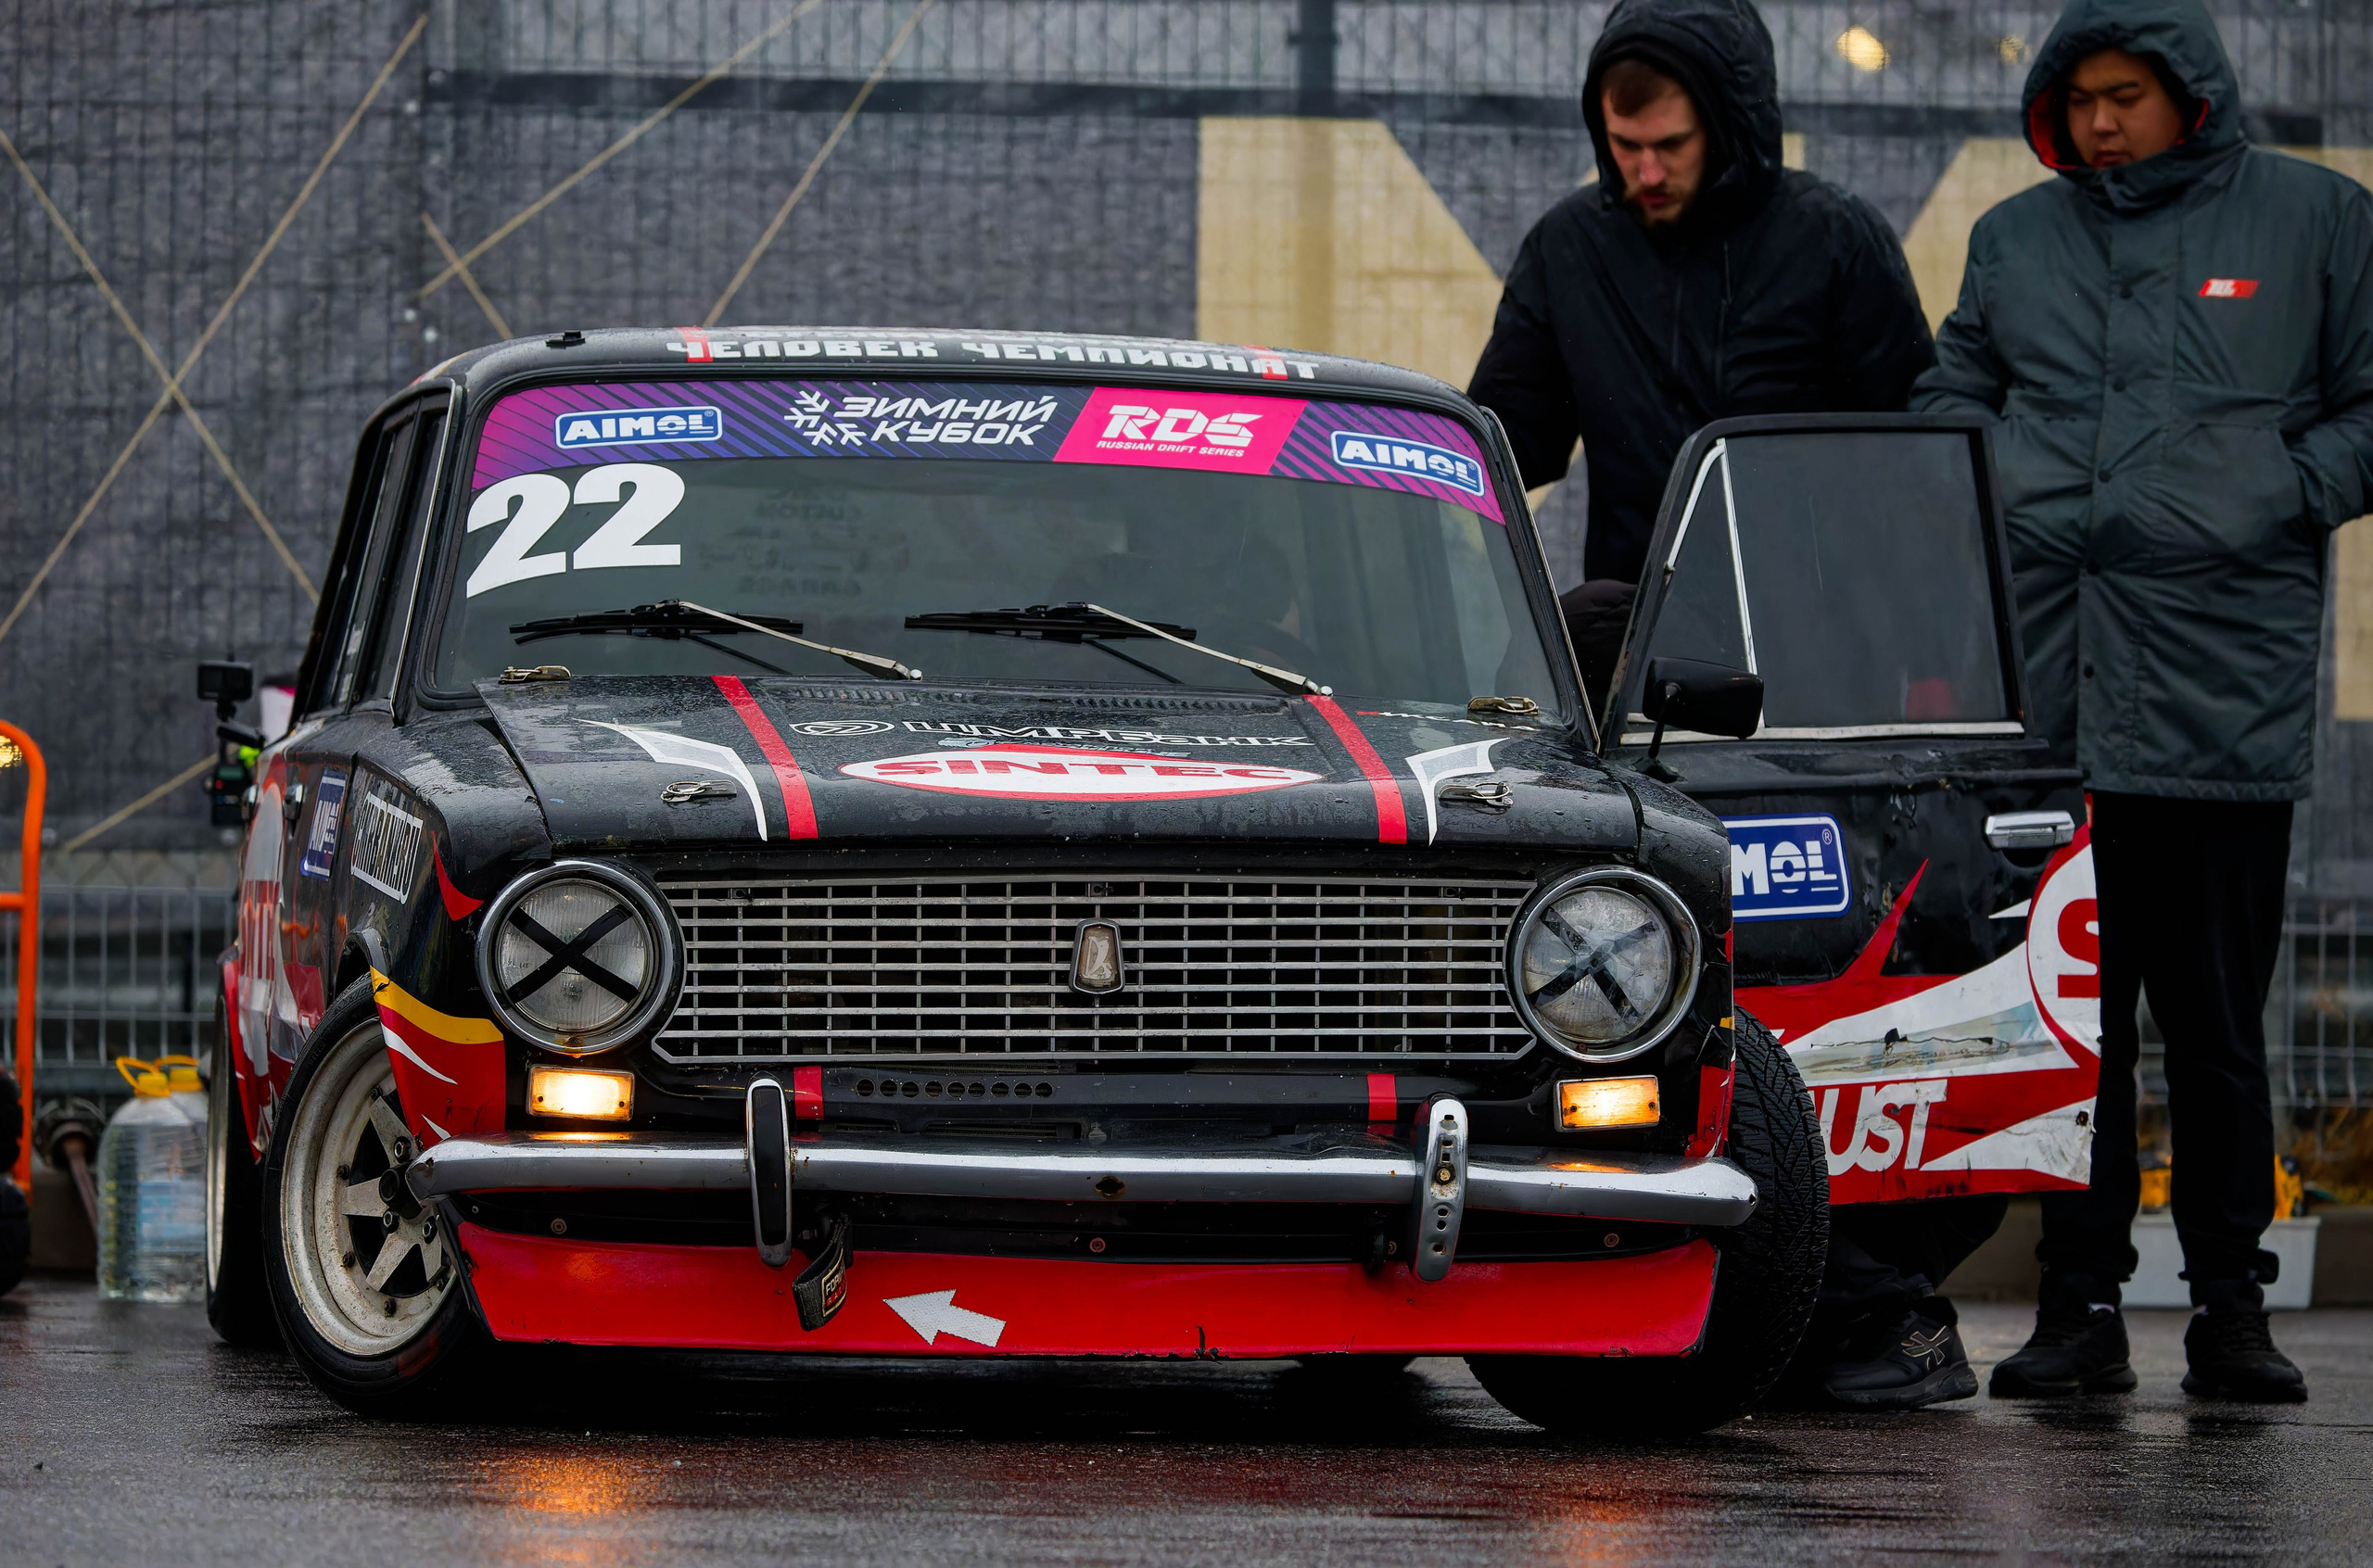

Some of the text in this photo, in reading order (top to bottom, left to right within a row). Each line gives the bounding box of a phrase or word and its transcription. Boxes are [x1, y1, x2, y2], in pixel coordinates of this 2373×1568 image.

[666, 340, 1319, 380] ЧЕЛОВЕК ЧЕМПИОНАТ
[564, 413, 716, 441] AIMOL
[833, 395, 1059, 423] ЗИМНИЙ
[1101, 403, 1264, 448] RDS
[870, 420, 1045, 446] КУБОК
[1096, 439, 1245, 458] RUSSIAN DRIFT SERIES
[1340, 439, 1478, 487] AIMOL
[466, 462, 686, 599] 22
[873, 758, 1292, 780] SINTEC
[1731, 840, 1838, 896] MOL
[1808, 1079, 1948, 1176] UST
